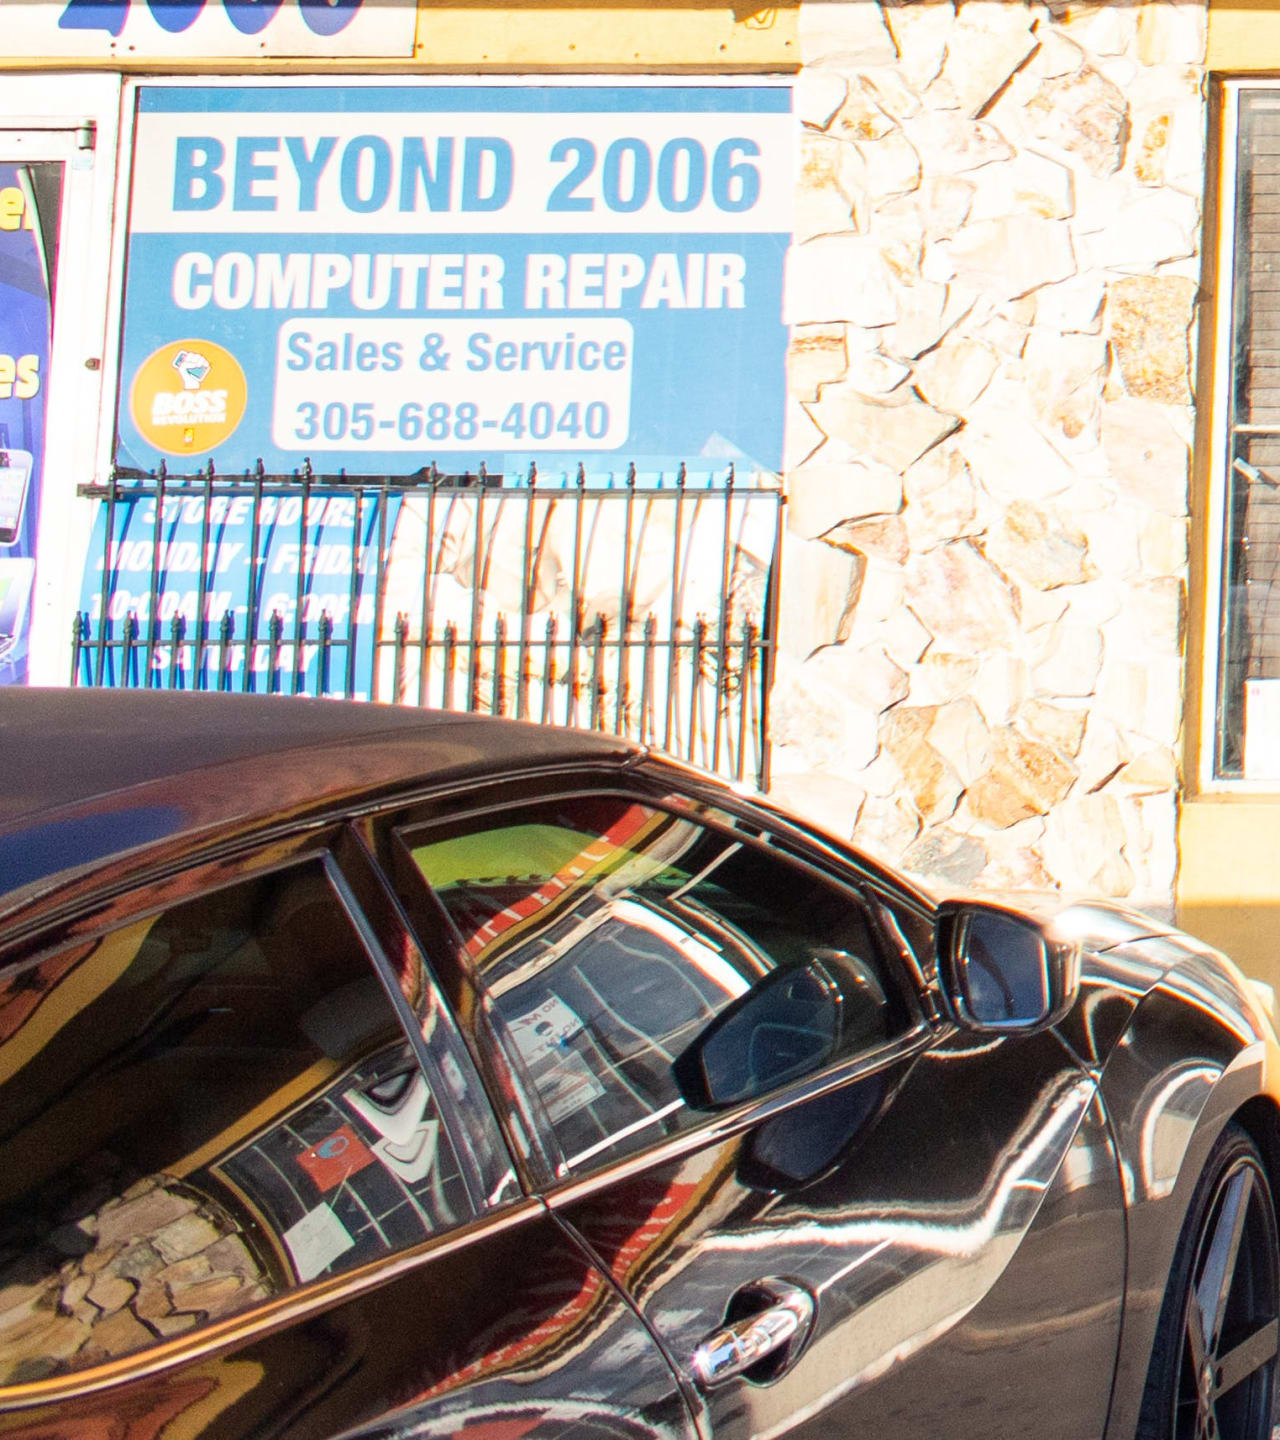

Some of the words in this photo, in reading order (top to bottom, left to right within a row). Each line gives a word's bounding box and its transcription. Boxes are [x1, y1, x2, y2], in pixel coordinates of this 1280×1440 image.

[171, 134, 515, 214] BEYOND
[545, 136, 762, 214] 2006
[174, 252, 504, 309] COMPUTER
[525, 253, 746, 309] REPAIR
[286, 331, 402, 372] Sales
[418, 333, 451, 373] &
[466, 331, 627, 373] Service
[152, 389, 229, 415] BOSS
[294, 401, 609, 442] 305-688-4040
[143, 495, 254, 526] STORE
[259, 496, 369, 528] HOURS
[96, 541, 245, 573] MONDAY
